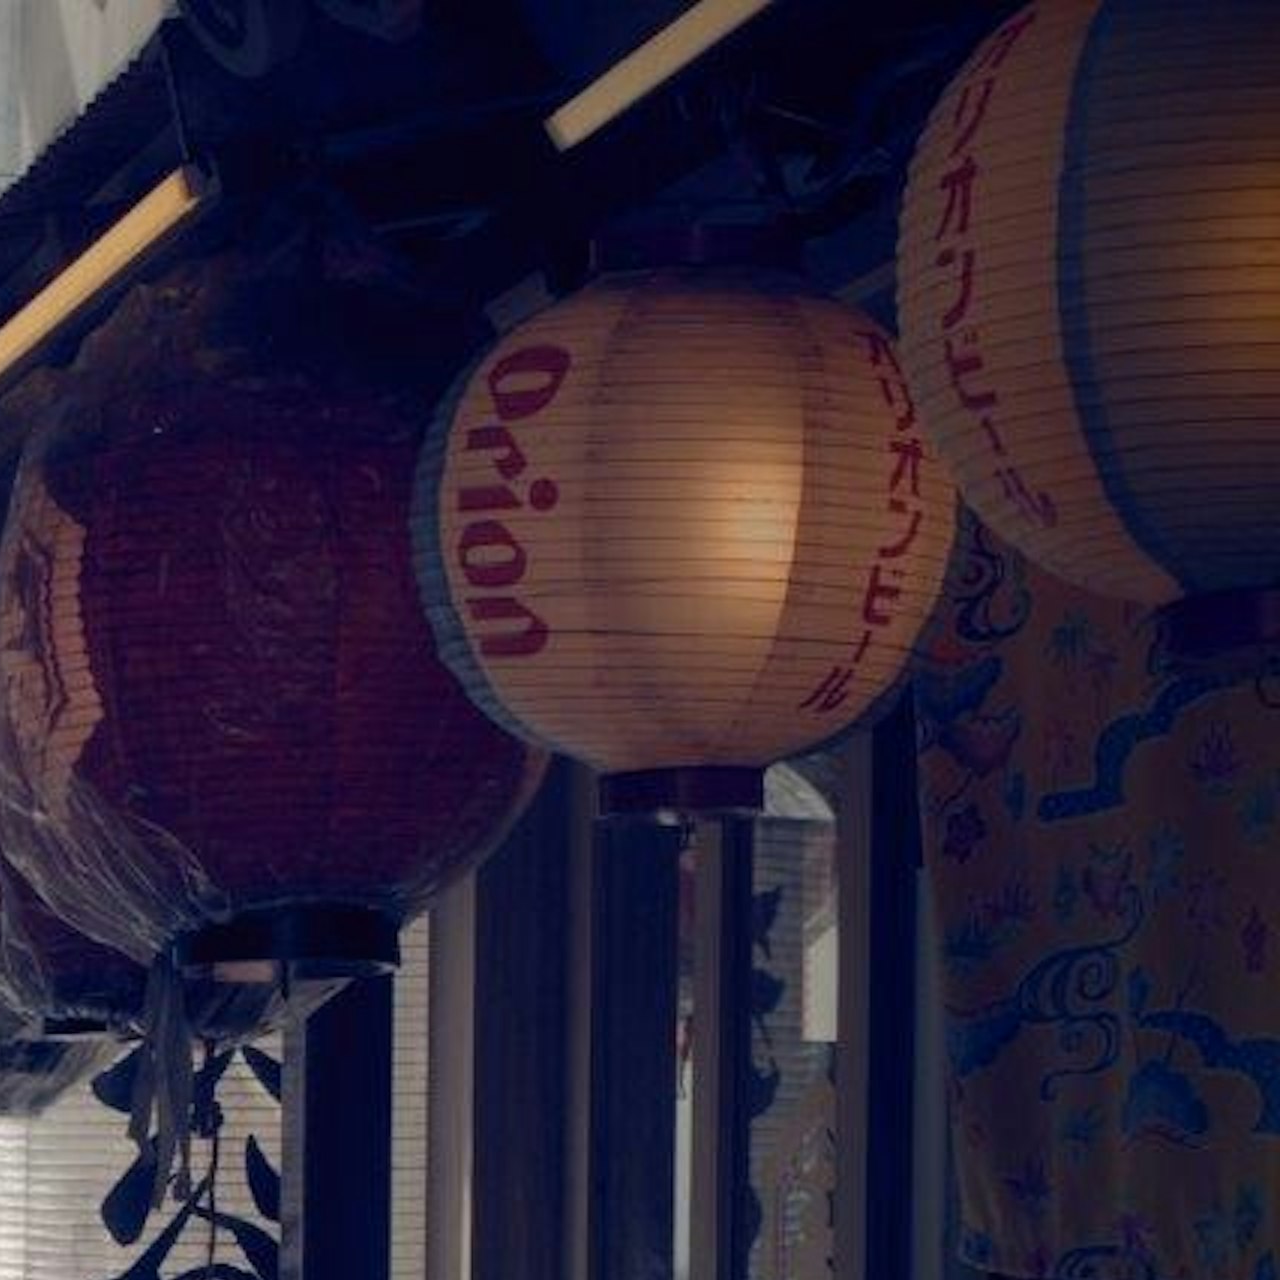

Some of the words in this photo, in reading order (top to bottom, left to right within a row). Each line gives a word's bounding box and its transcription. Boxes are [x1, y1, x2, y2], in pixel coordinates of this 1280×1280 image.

[457, 346, 571, 656] Orion
[800, 330, 922, 712] オリオンビール
